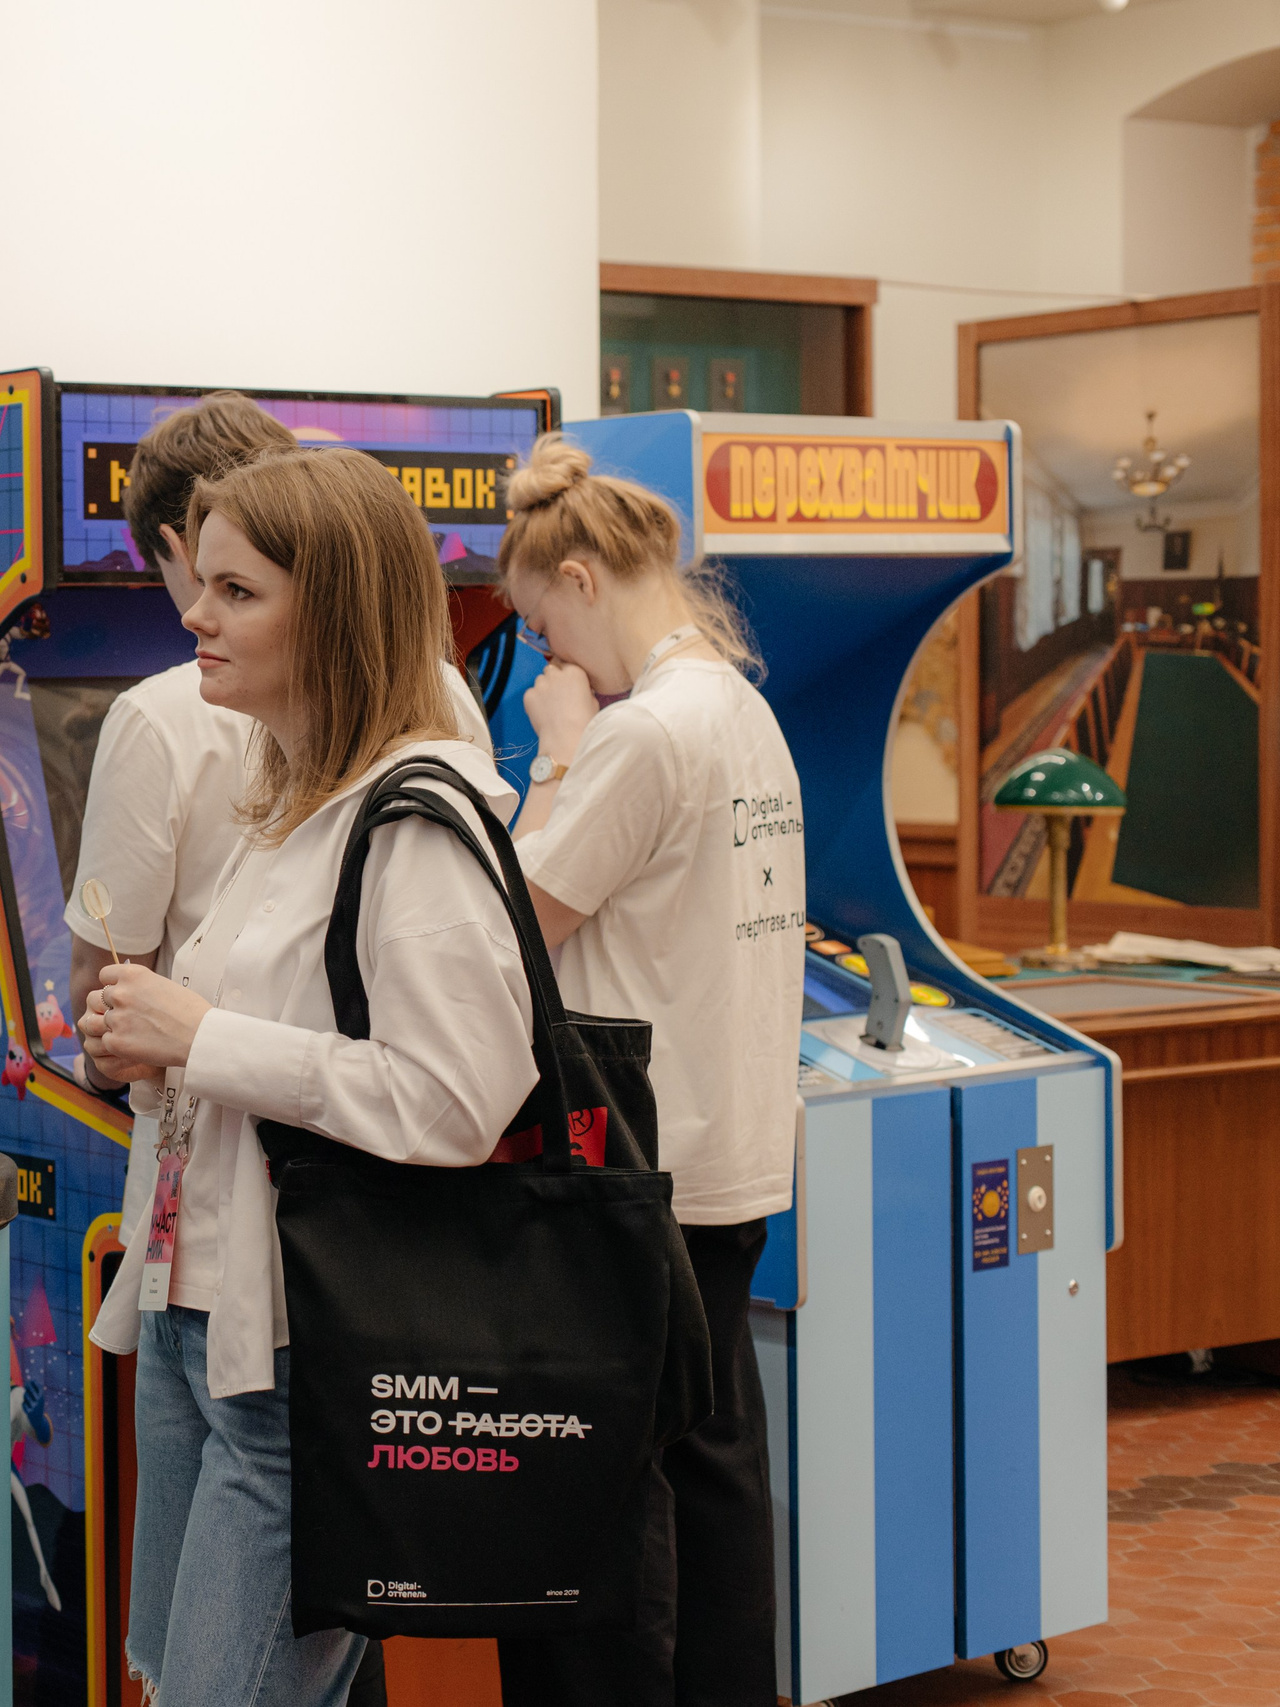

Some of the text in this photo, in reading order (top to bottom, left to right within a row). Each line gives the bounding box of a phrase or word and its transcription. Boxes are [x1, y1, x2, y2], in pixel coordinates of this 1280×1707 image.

[751, 818, 804, 840] оттепель
[735, 910, 805, 943] onephrase.ru
[371, 1374, 459, 1400] SMM
[370, 1409, 591, 1438] ЭТО РАБОТА
[367, 1444, 519, 1472] ЛЮБОВЬ
[387, 1590, 427, 1598] оттепель
